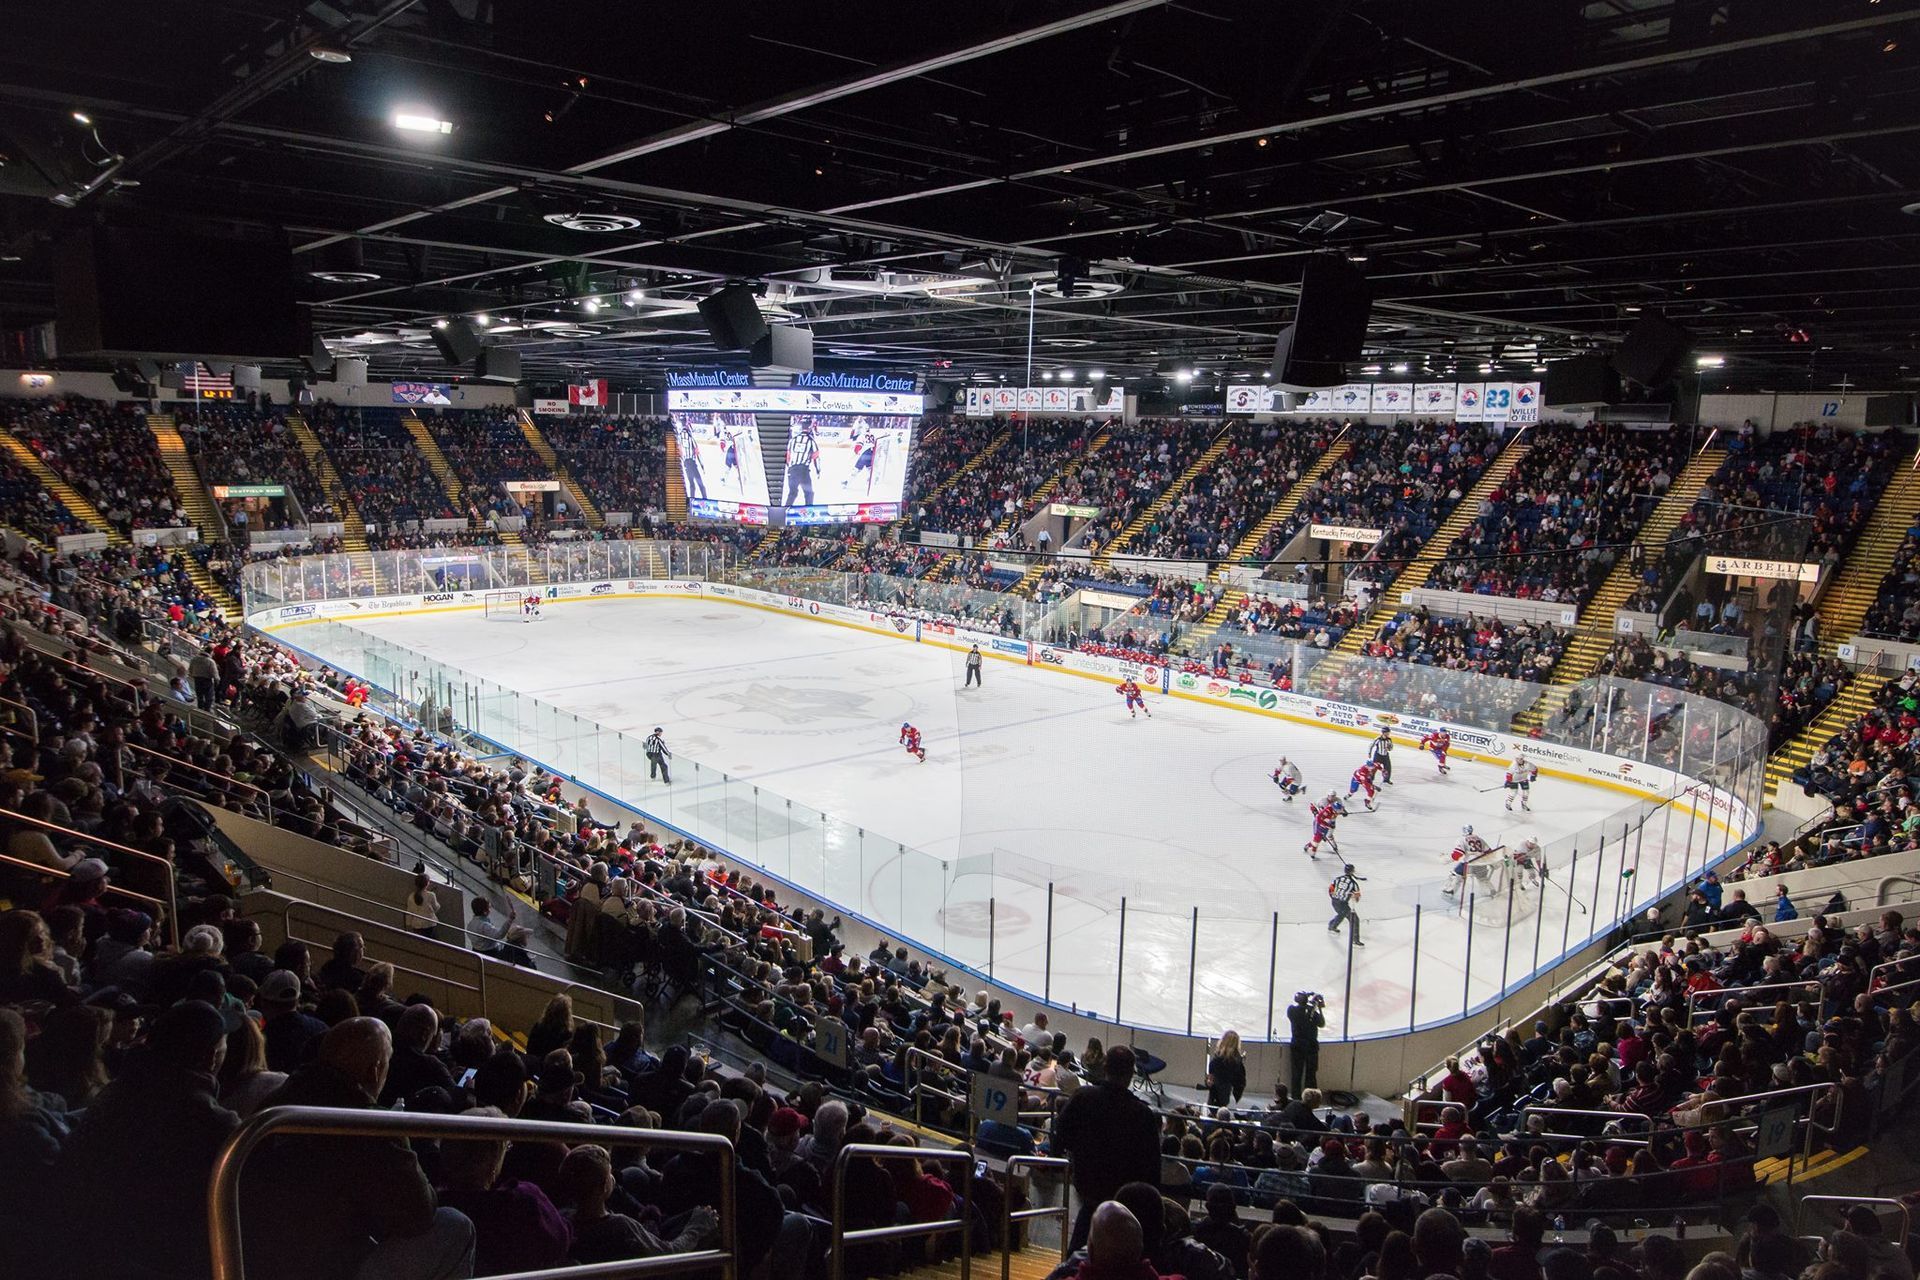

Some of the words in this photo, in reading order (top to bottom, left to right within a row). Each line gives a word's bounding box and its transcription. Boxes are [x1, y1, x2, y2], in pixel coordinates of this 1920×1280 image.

[669, 372, 718, 387] MassMutual
[720, 371, 749, 386] Center
[797, 372, 873, 389] MassMutual
[876, 375, 914, 391] Center
[970, 392, 976, 406] 2
[1486, 390, 1510, 408] 23
[1823, 402, 1838, 416] 12
[1312, 526, 1339, 539] Kentucky
[1340, 529, 1356, 539] Fried
[1356, 531, 1380, 540] Chicken
[1730, 560, 1807, 574] ARBELLA
[423, 593, 454, 602] HOGAN
[788, 597, 805, 609] USA
[1841, 647, 1851, 656] 12
[1326, 702, 1359, 713] GENDEN
[1330, 717, 1355, 727] PARTS
[1333, 711, 1353, 719] AUTO
[1459, 732, 1492, 746] LOTTERY
[1588, 767, 1623, 780] FONTAINE
[1646, 782, 1661, 790] INC.
[825, 1031, 838, 1055] 21
[1023, 1069, 1042, 1086] 34
[984, 1087, 1007, 1111] 19
